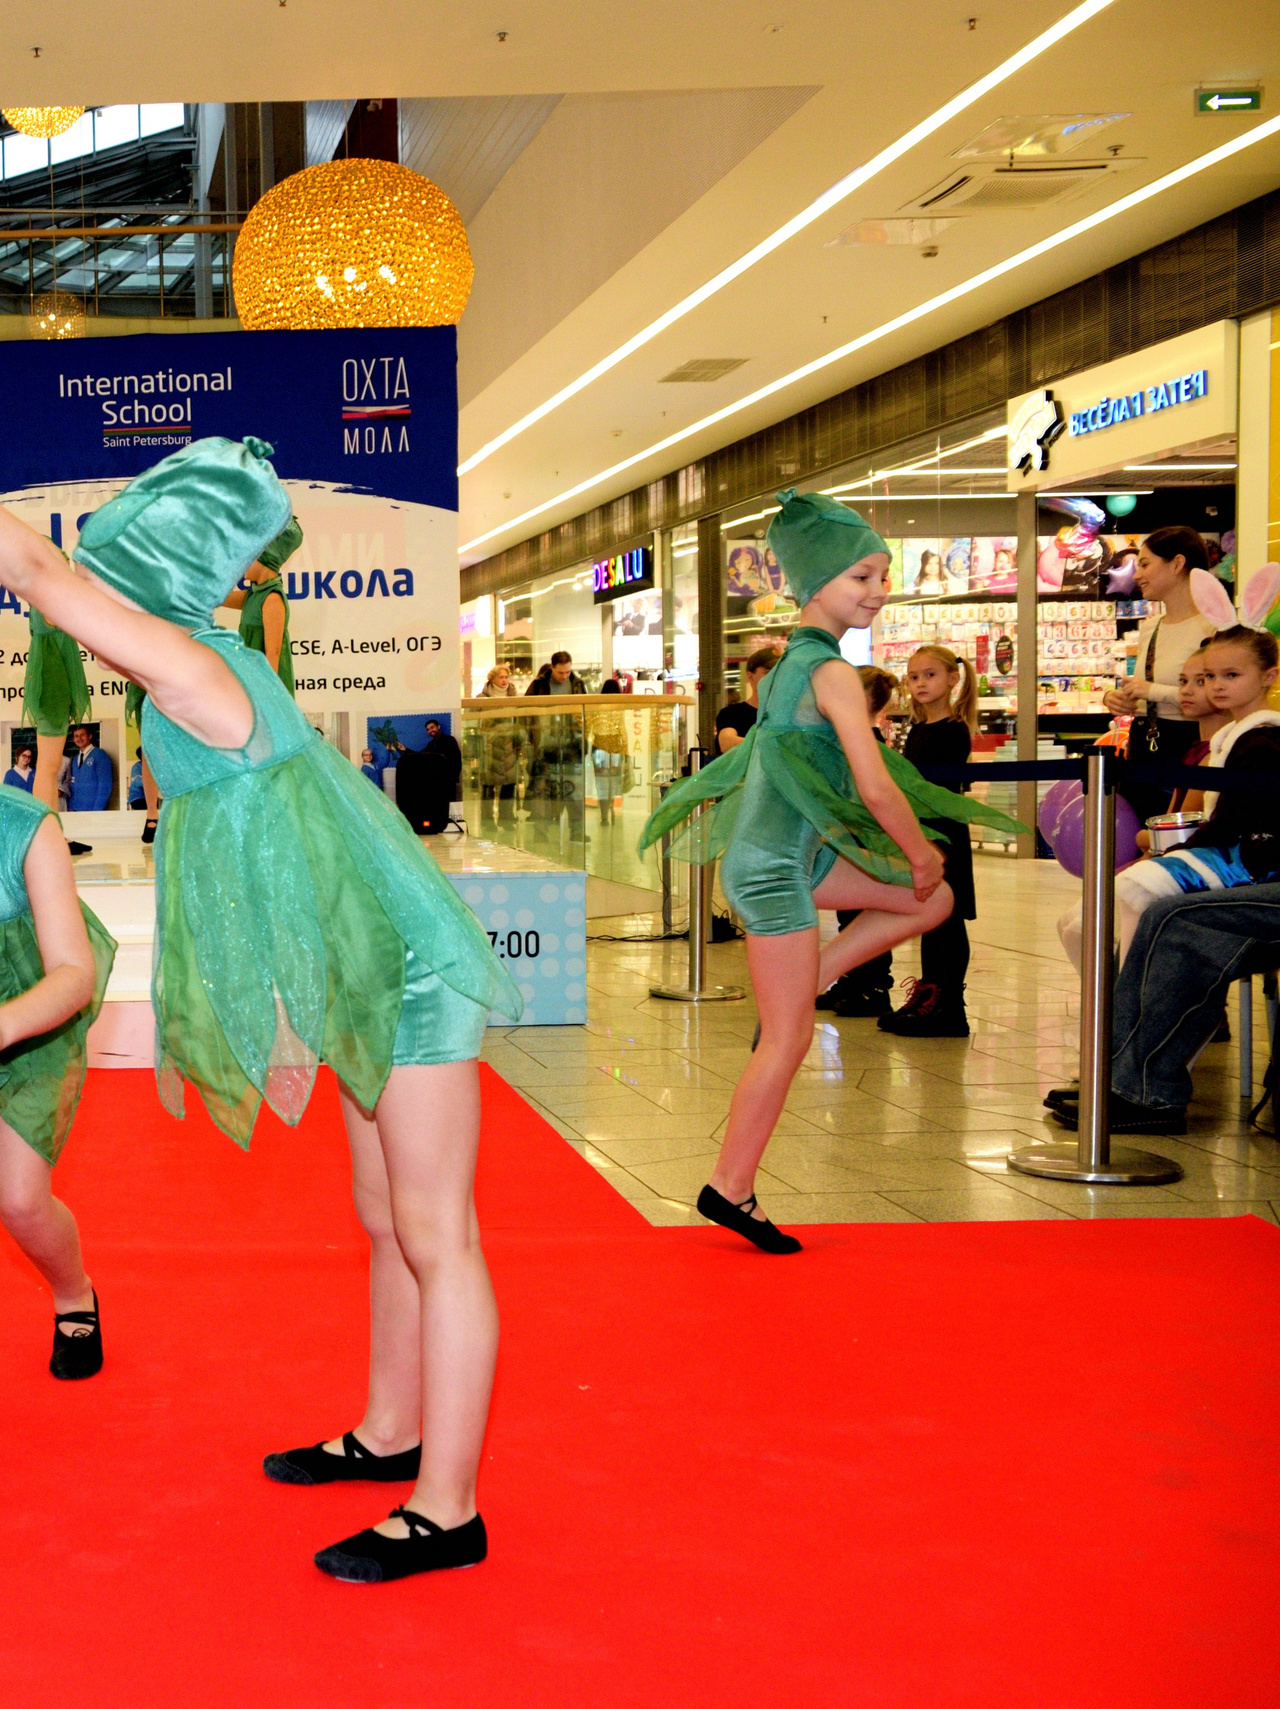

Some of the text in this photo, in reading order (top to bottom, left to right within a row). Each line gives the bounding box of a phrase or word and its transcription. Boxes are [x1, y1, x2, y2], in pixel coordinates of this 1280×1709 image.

[59, 366, 233, 398] International
[341, 357, 411, 402] ОХТА
[101, 397, 192, 425] School
[1068, 392, 1144, 438] ВЕСЁЛАЯ
[1145, 369, 1208, 414] ЗАТЕЯ
[103, 432, 193, 448] Saint Petersburg
[592, 547, 643, 593] DESALU
[331, 637, 401, 655] A-Level,
[406, 636, 442, 652] ОГЭ
[332, 676, 386, 693] среда
